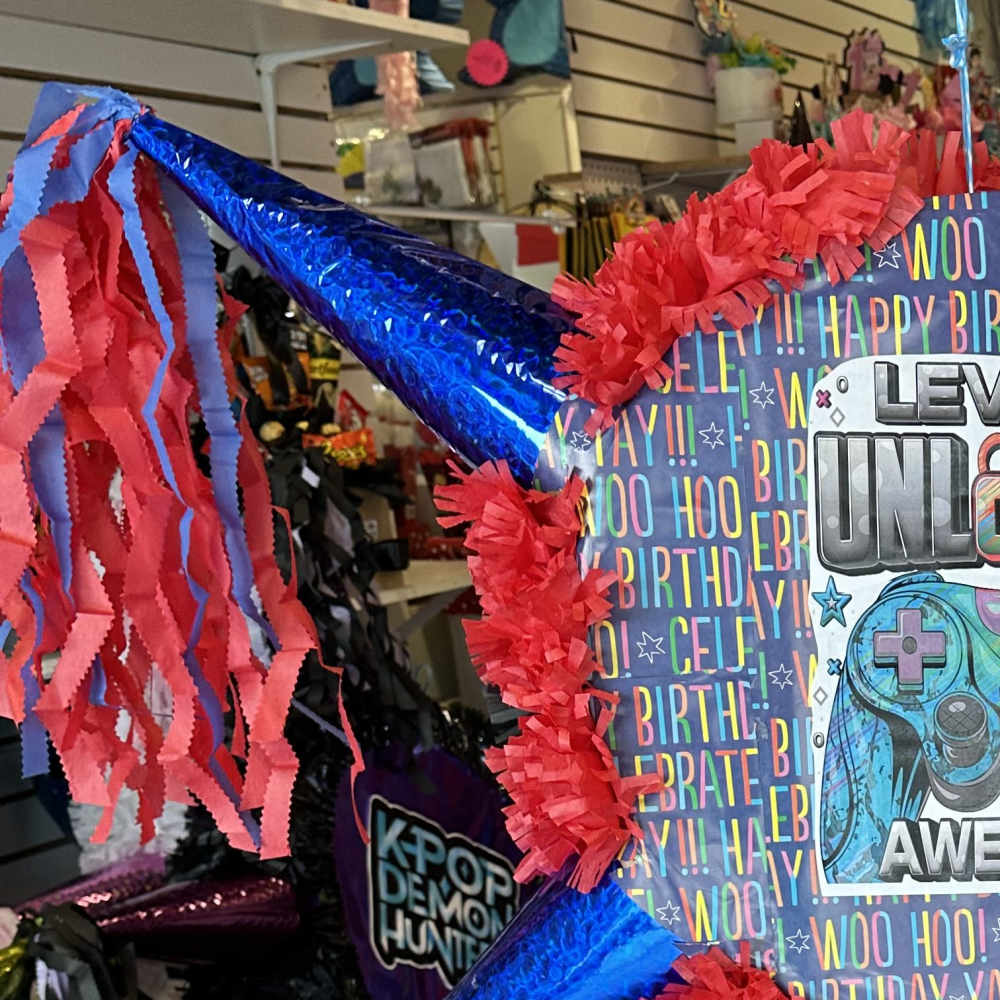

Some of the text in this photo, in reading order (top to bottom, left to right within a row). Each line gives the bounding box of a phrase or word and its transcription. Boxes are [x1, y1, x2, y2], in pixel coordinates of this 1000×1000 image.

[902, 217, 987, 281] WOO
[817, 293, 935, 359] HAPPY
[376, 810, 514, 906] K-POP
[379, 902, 490, 976] HUNTE
[680, 880, 768, 943] WOO
[808, 910, 894, 971] WOO
[910, 907, 988, 968] HOO!
